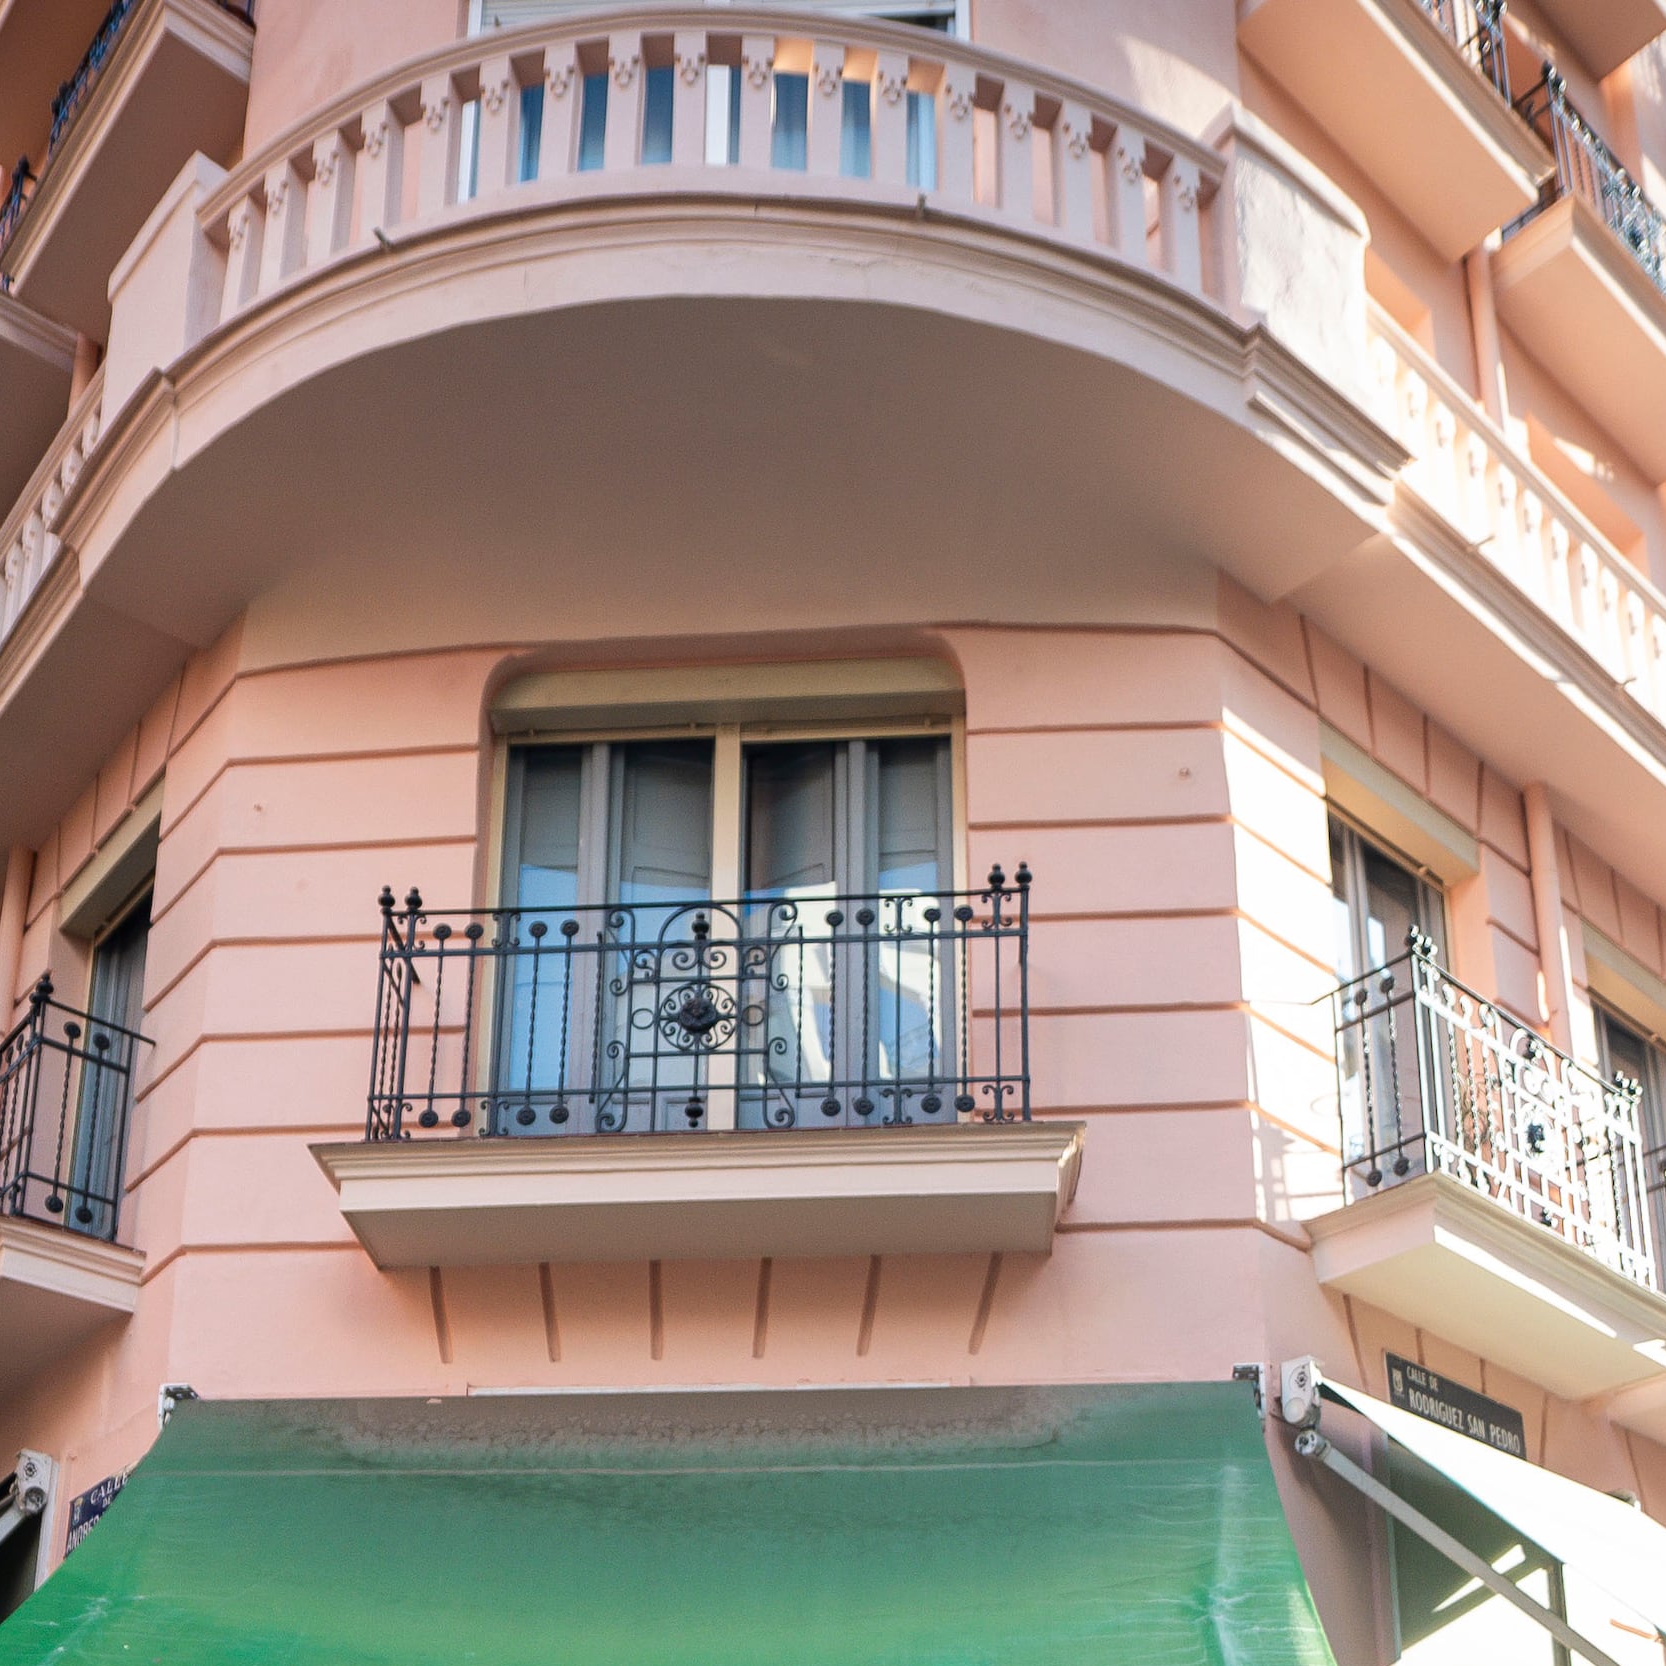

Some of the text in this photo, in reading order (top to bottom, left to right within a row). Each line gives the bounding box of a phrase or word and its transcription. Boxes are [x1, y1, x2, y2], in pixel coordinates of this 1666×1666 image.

[1406, 1365, 1427, 1387] CALLE
[1408, 1387, 1521, 1454] RODRIGUEZ SAN PEDRO
